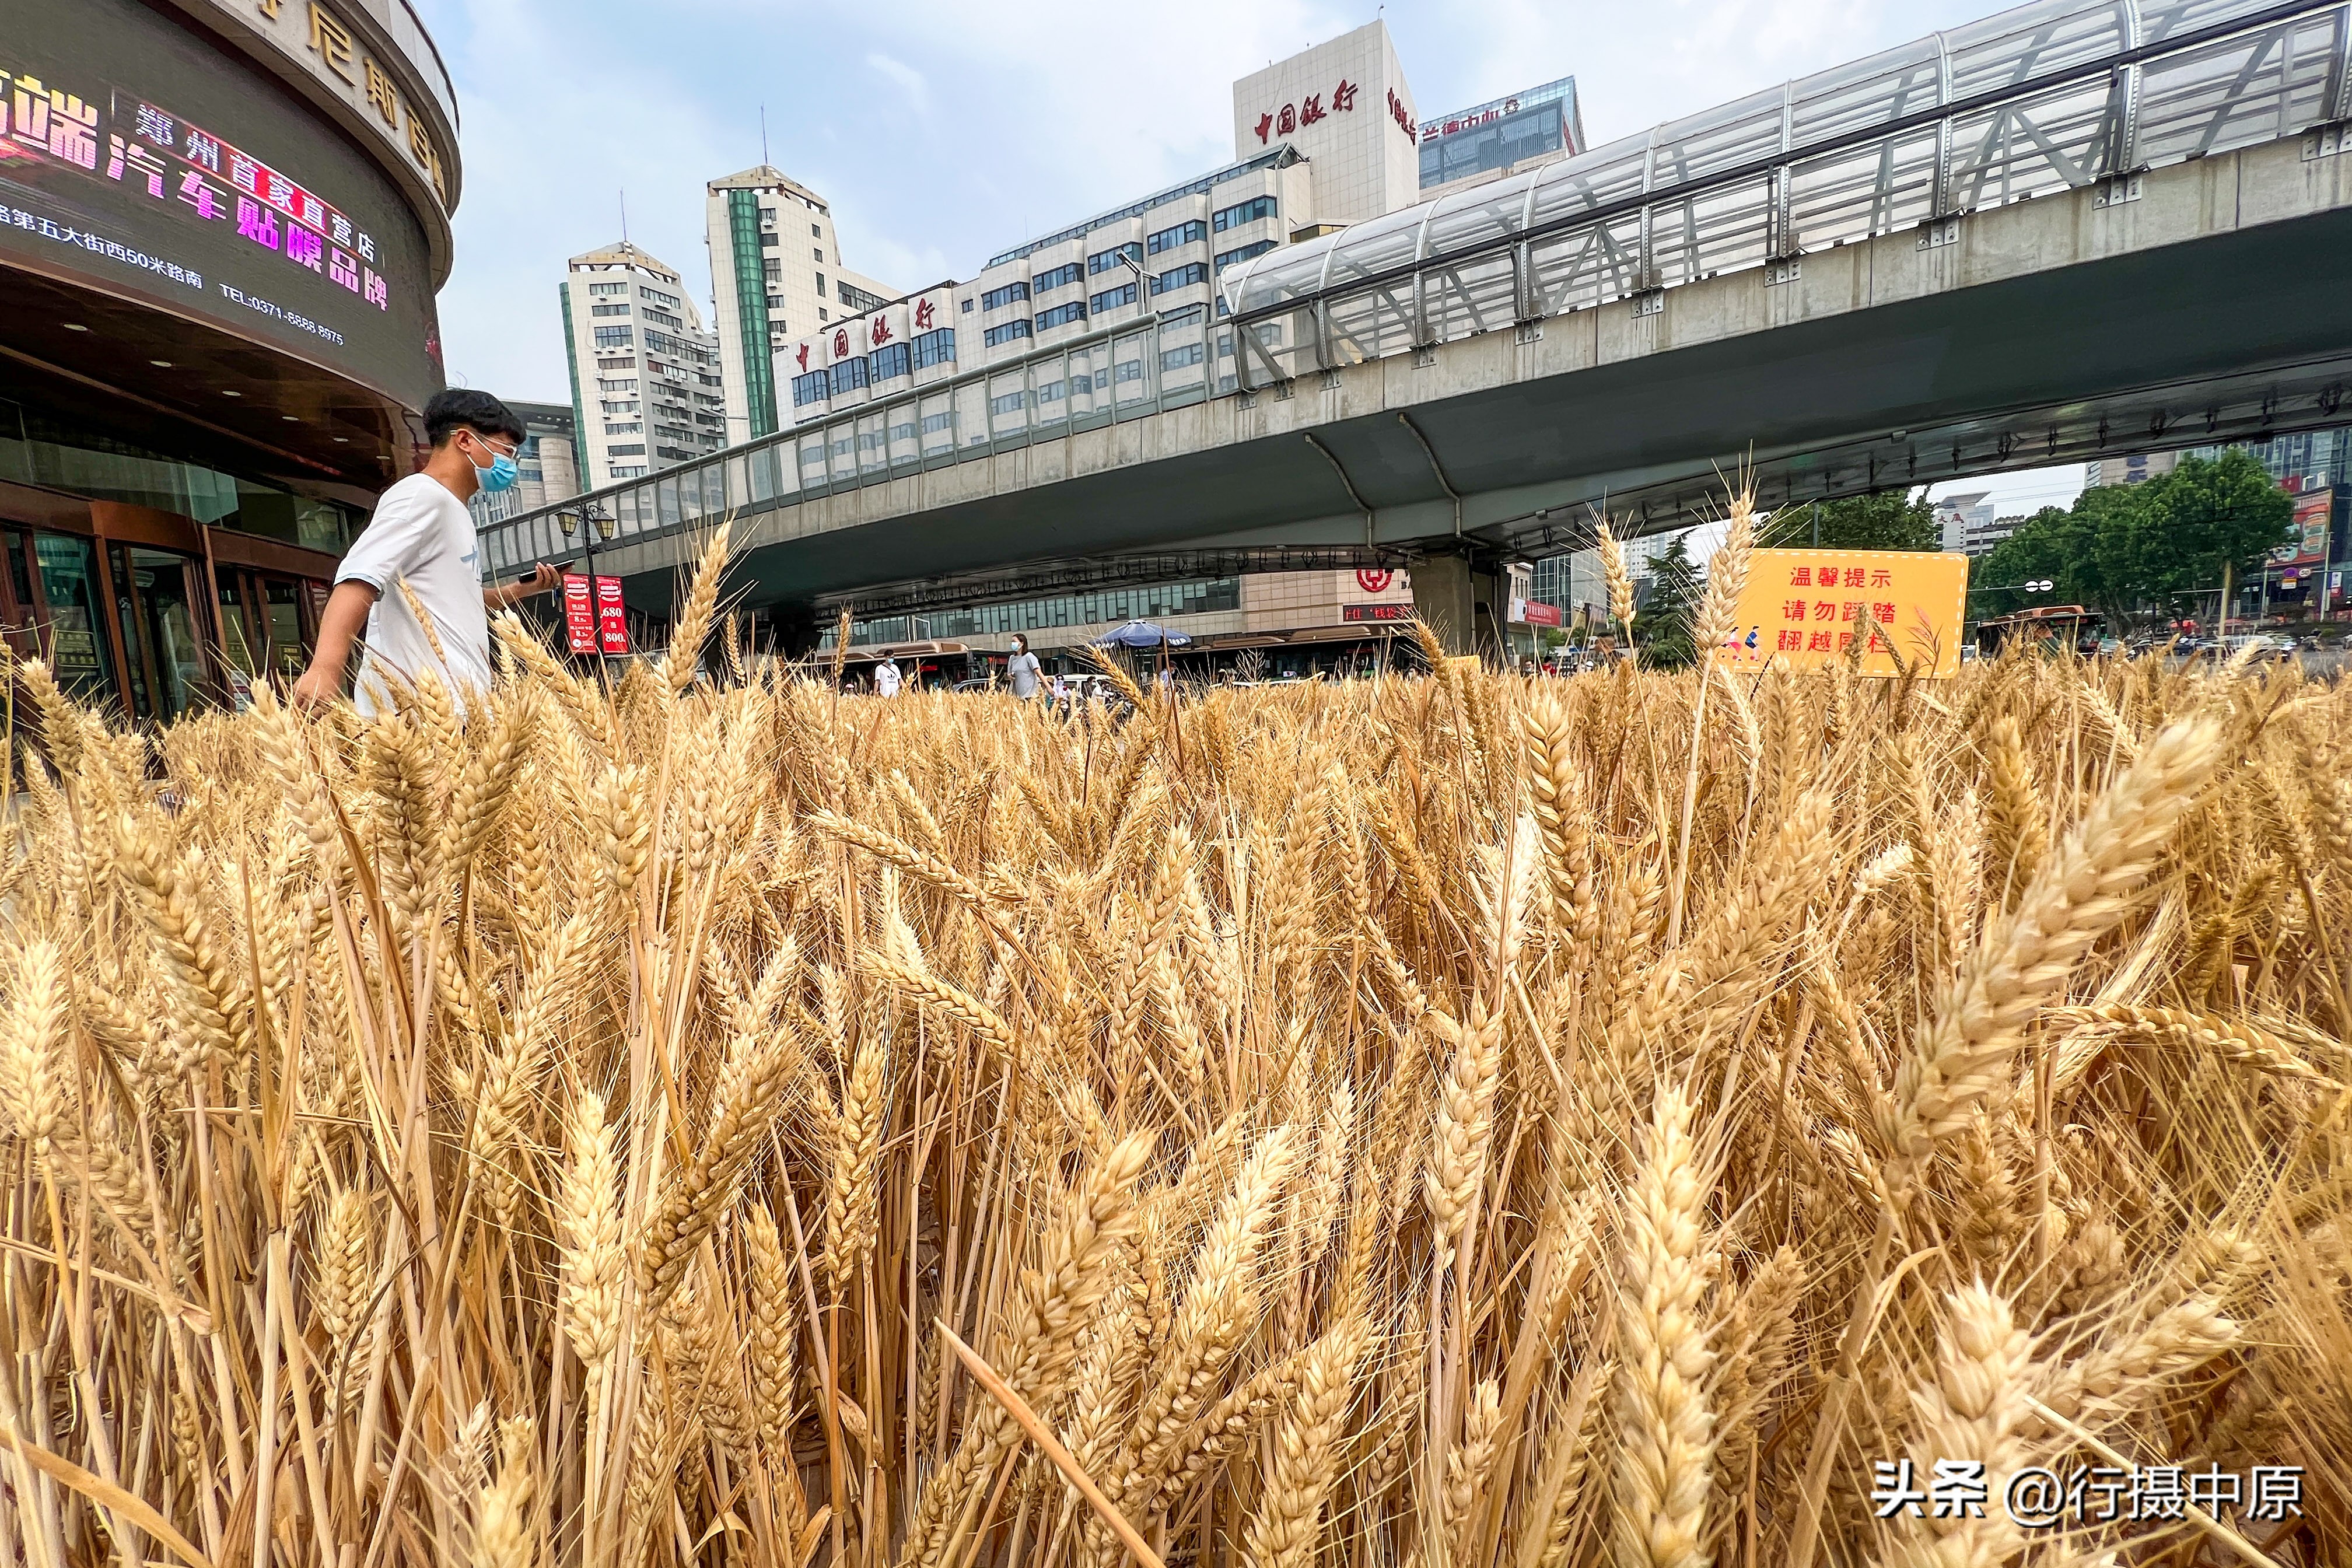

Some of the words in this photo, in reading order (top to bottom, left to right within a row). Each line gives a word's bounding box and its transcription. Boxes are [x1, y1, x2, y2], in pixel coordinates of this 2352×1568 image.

[1255, 79, 1359, 145] 中国银行
[136, 103, 374, 263] 郑州首家直营店
[796, 298, 935, 373] 中国银行
[1790, 566, 1892, 589] 温馨提示
